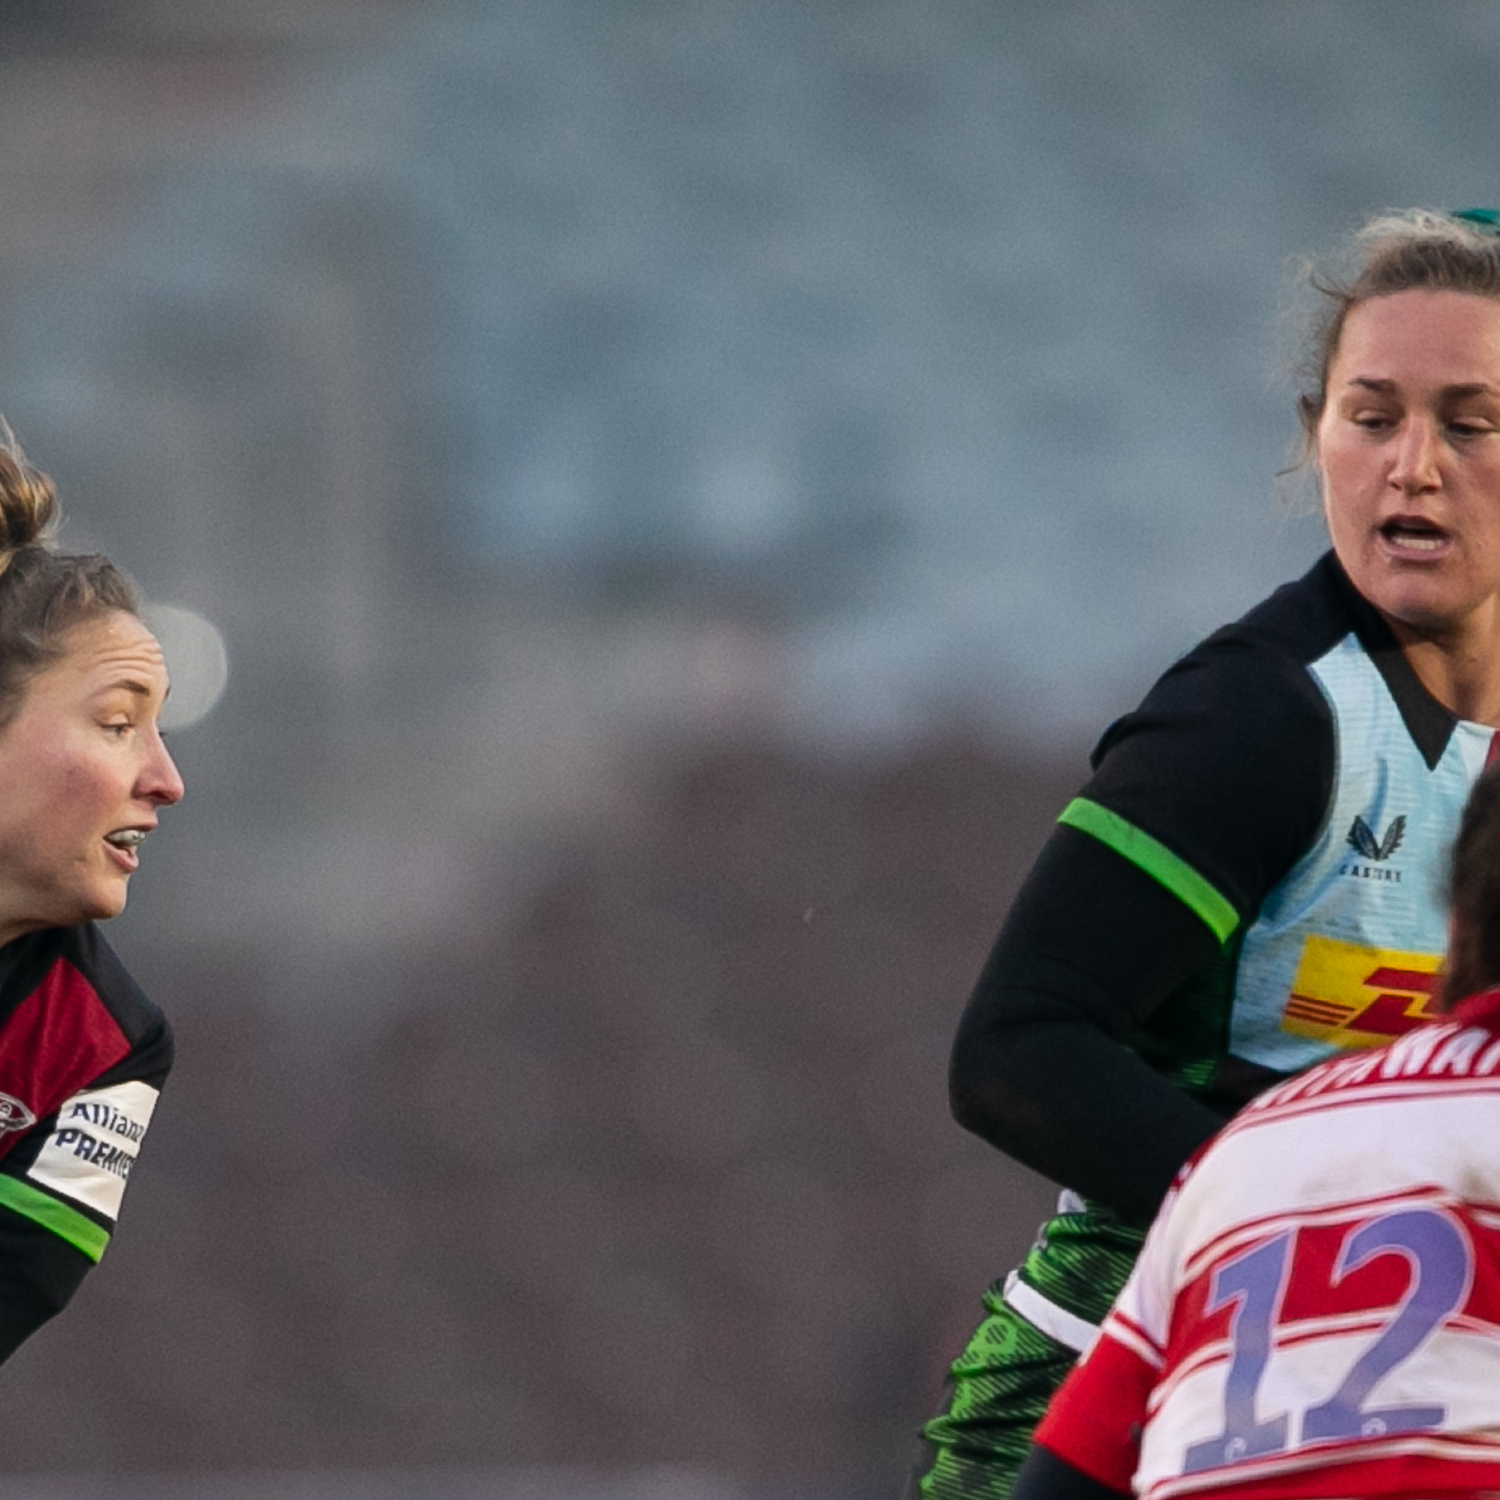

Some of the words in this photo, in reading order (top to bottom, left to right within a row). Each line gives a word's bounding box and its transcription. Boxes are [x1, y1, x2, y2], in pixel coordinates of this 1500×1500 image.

[70, 1103, 145, 1143] Allianz
[54, 1129, 137, 1181] PREMIE
[1182, 1207, 1473, 1476] 12
